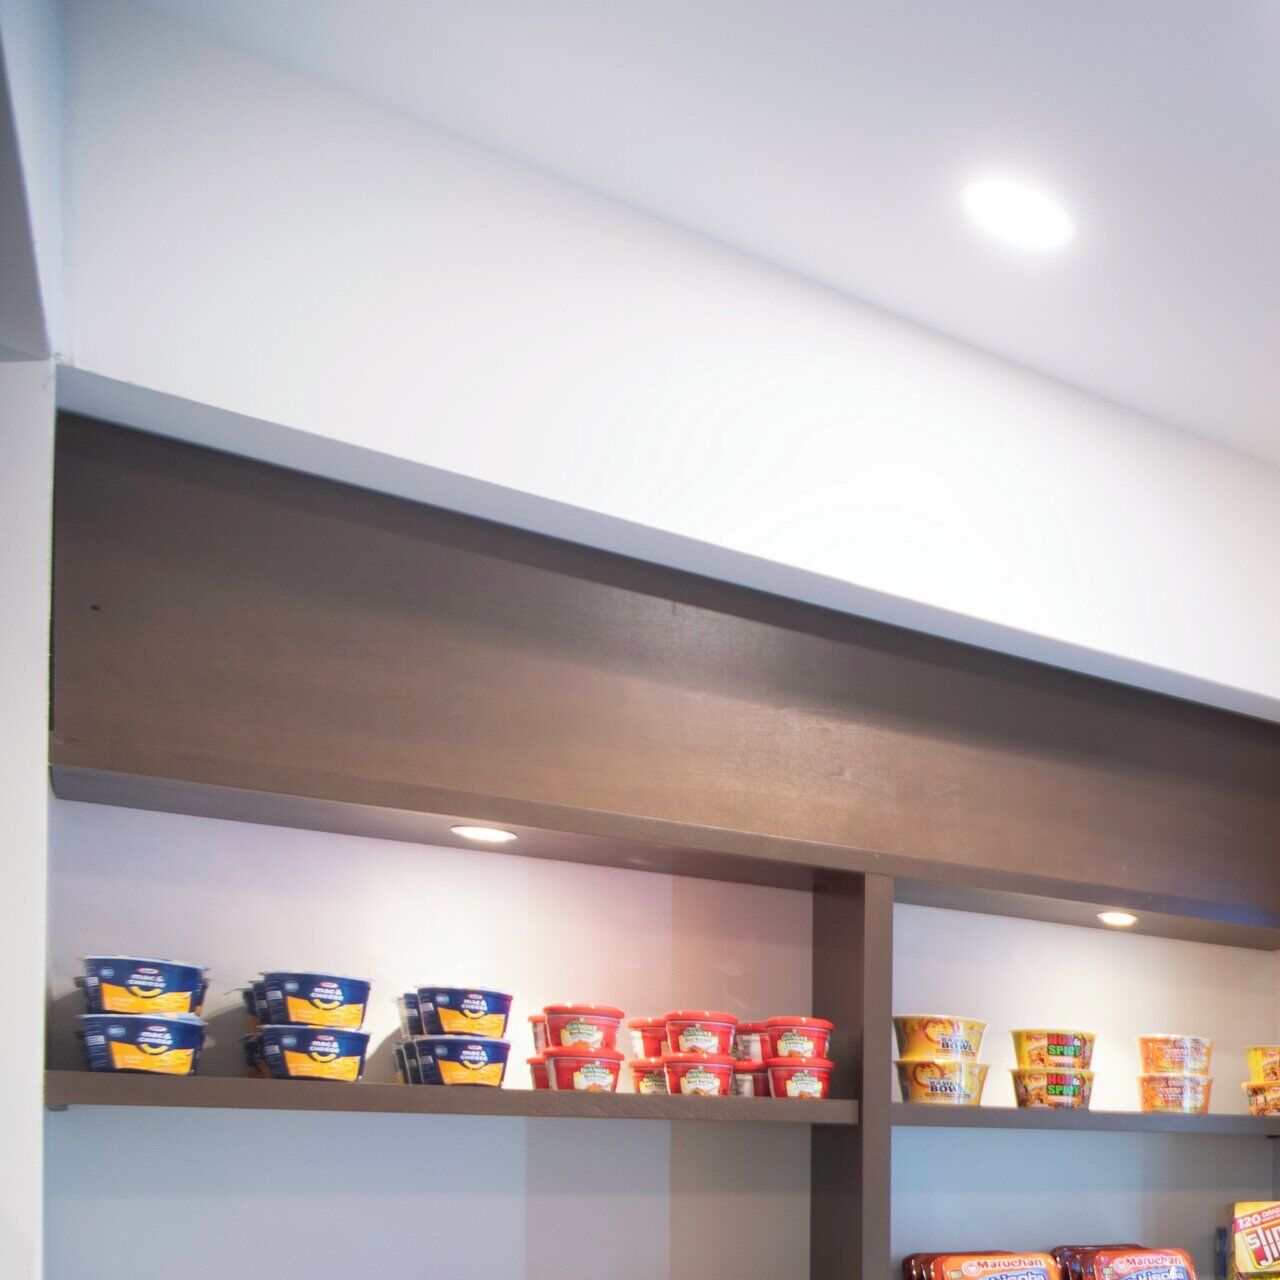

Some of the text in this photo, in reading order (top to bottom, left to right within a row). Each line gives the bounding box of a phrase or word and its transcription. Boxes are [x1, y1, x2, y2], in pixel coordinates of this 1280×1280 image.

[1047, 1033, 1073, 1045] HOT
[1048, 1045, 1081, 1056] SPICY
[1047, 1073, 1073, 1085] HOT
[1047, 1085, 1080, 1096] SPICY
[1238, 1214, 1261, 1229] 120
[976, 1258, 1043, 1269] Maruchan
[1126, 1256, 1181, 1266] Maruchan
